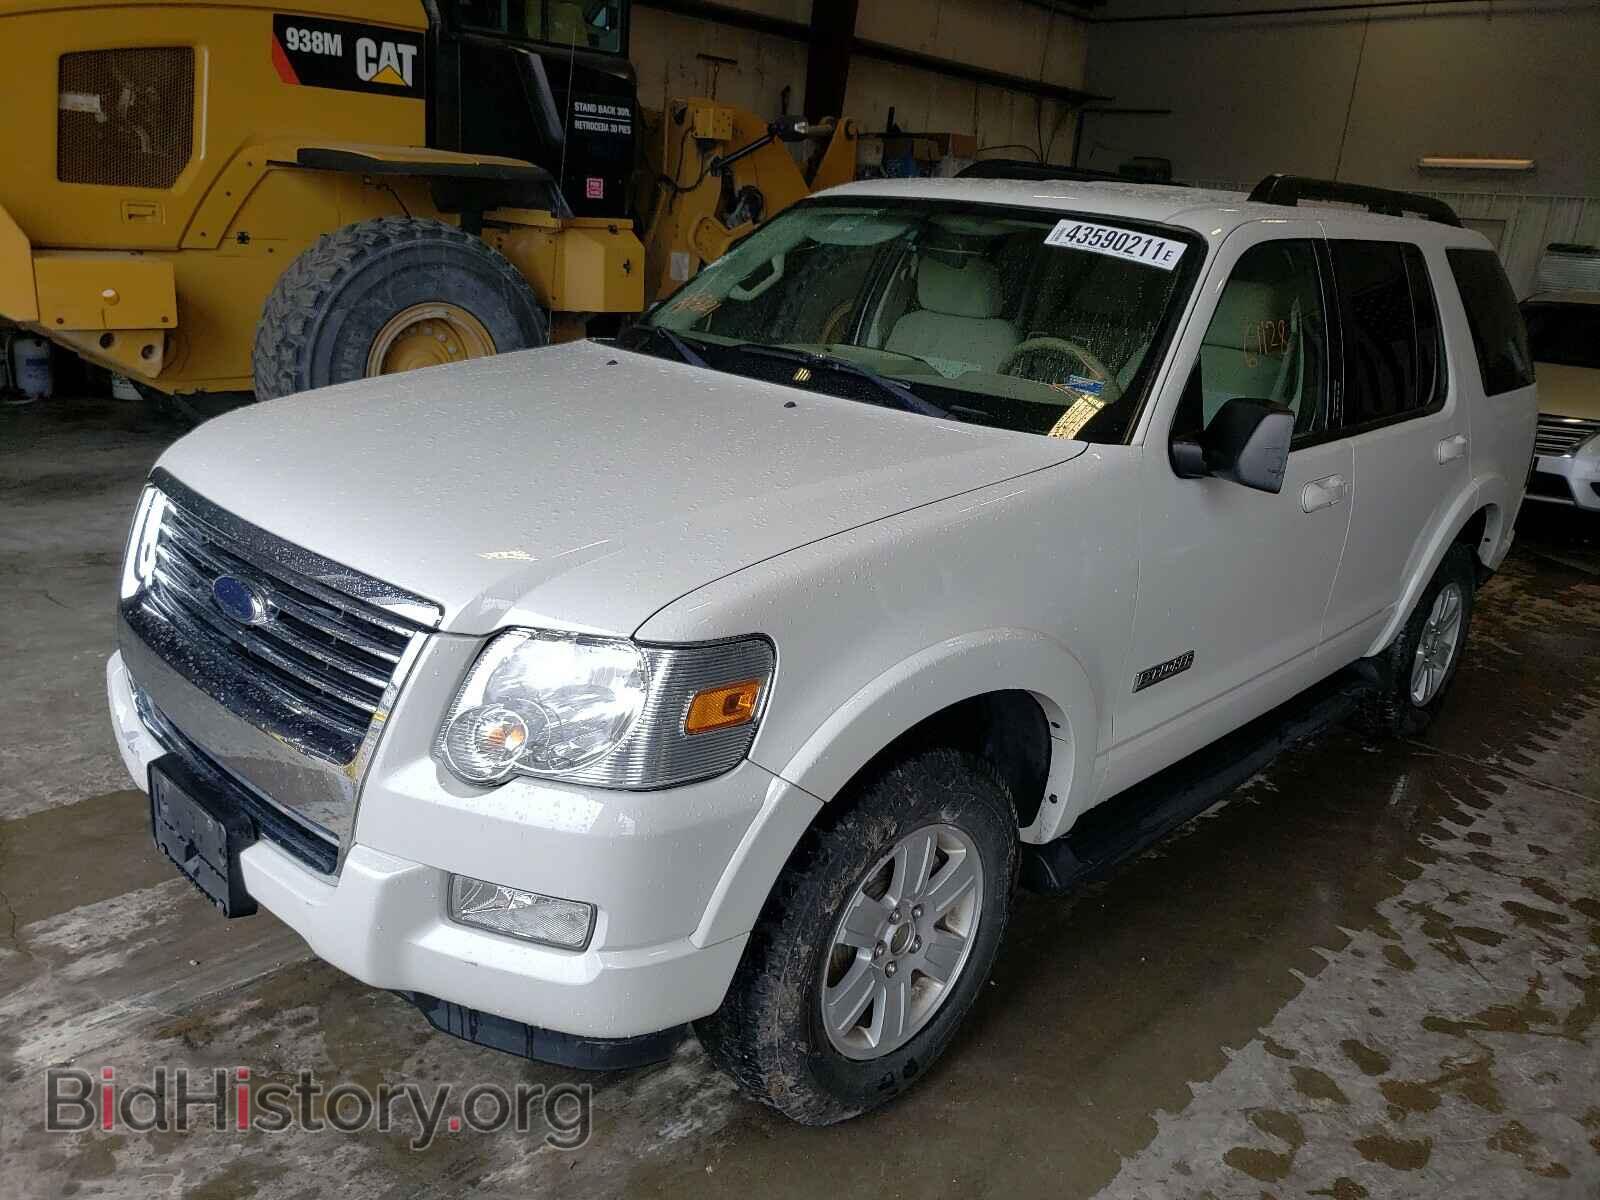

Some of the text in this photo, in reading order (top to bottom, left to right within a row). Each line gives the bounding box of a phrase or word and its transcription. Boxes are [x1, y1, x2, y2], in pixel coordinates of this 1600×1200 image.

[286, 27, 343, 57] 938M
[355, 37, 417, 87] CAT
[574, 102, 597, 113] STAND
[1065, 224, 1166, 260] 43590211
[1162, 250, 1174, 262] E
